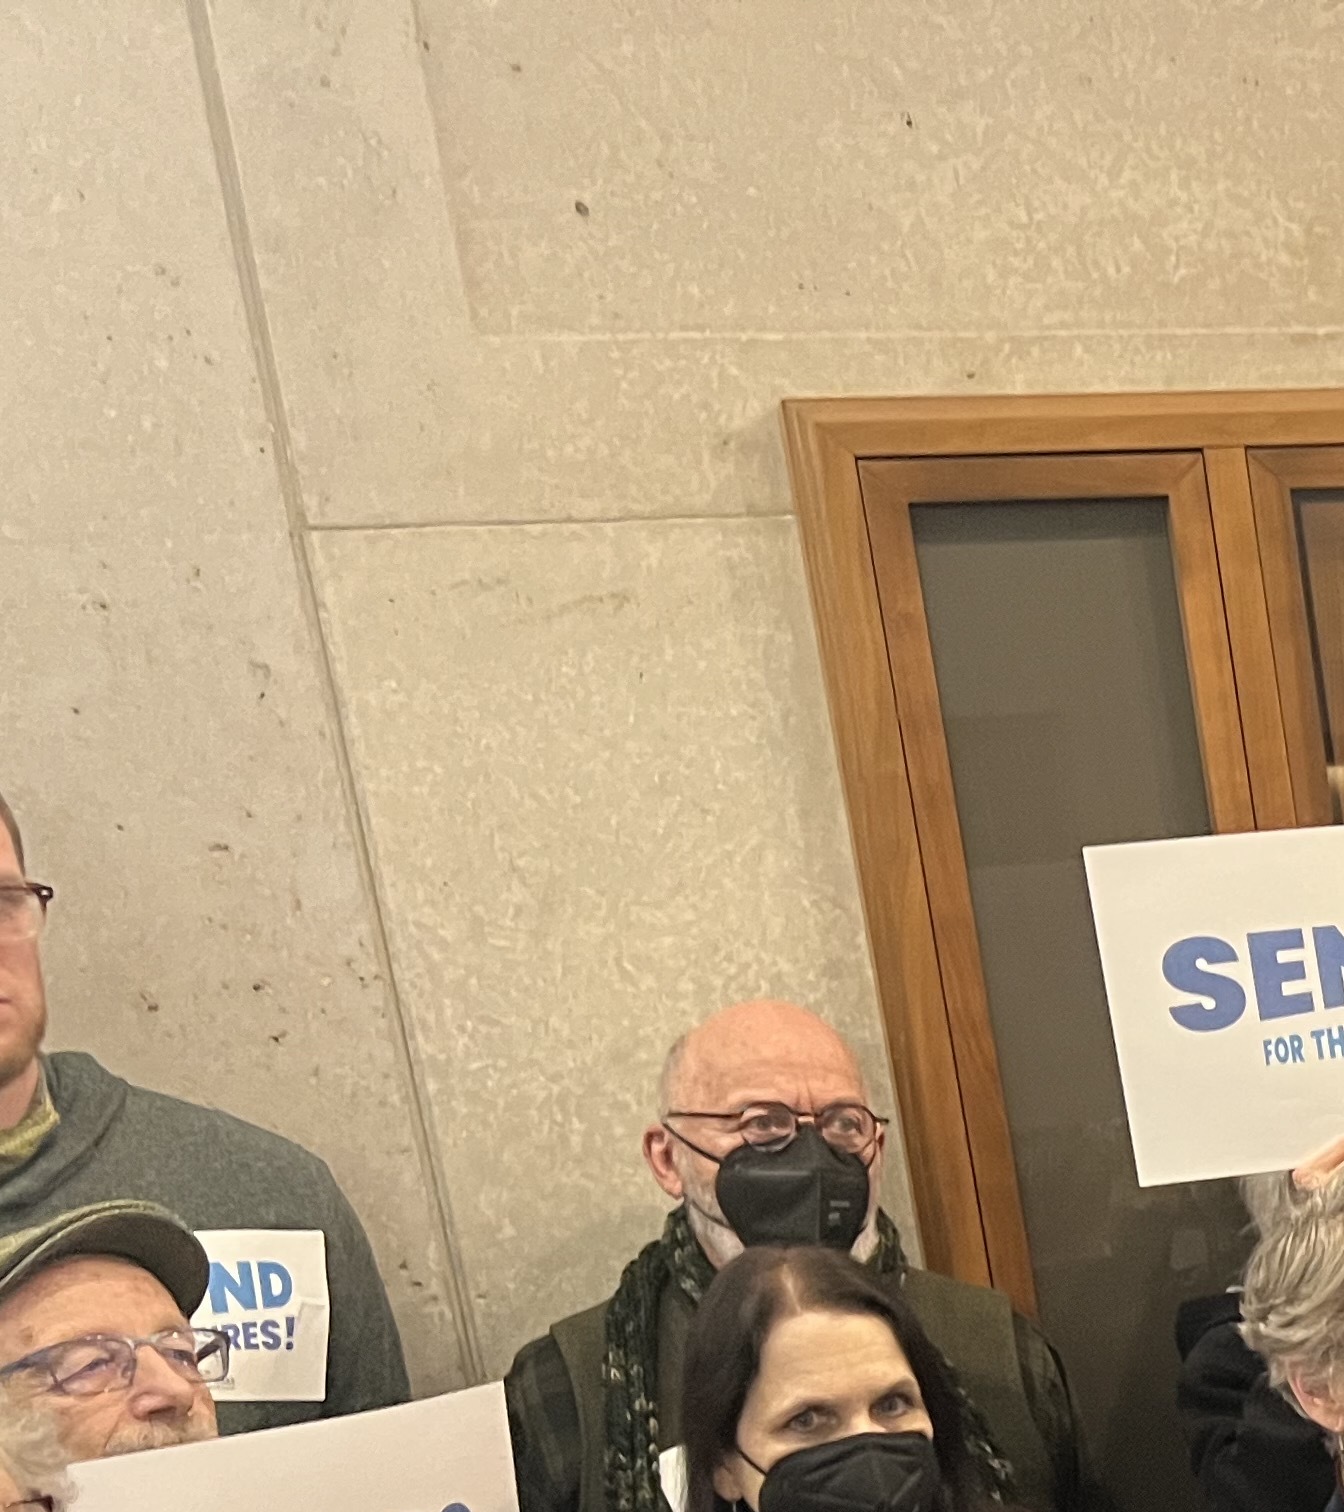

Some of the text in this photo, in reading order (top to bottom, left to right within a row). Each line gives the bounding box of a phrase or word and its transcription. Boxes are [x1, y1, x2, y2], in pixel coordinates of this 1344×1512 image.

[1263, 1034, 1304, 1066] FOR
[208, 1260, 293, 1315] ND
[220, 1316, 295, 1351] RES!
